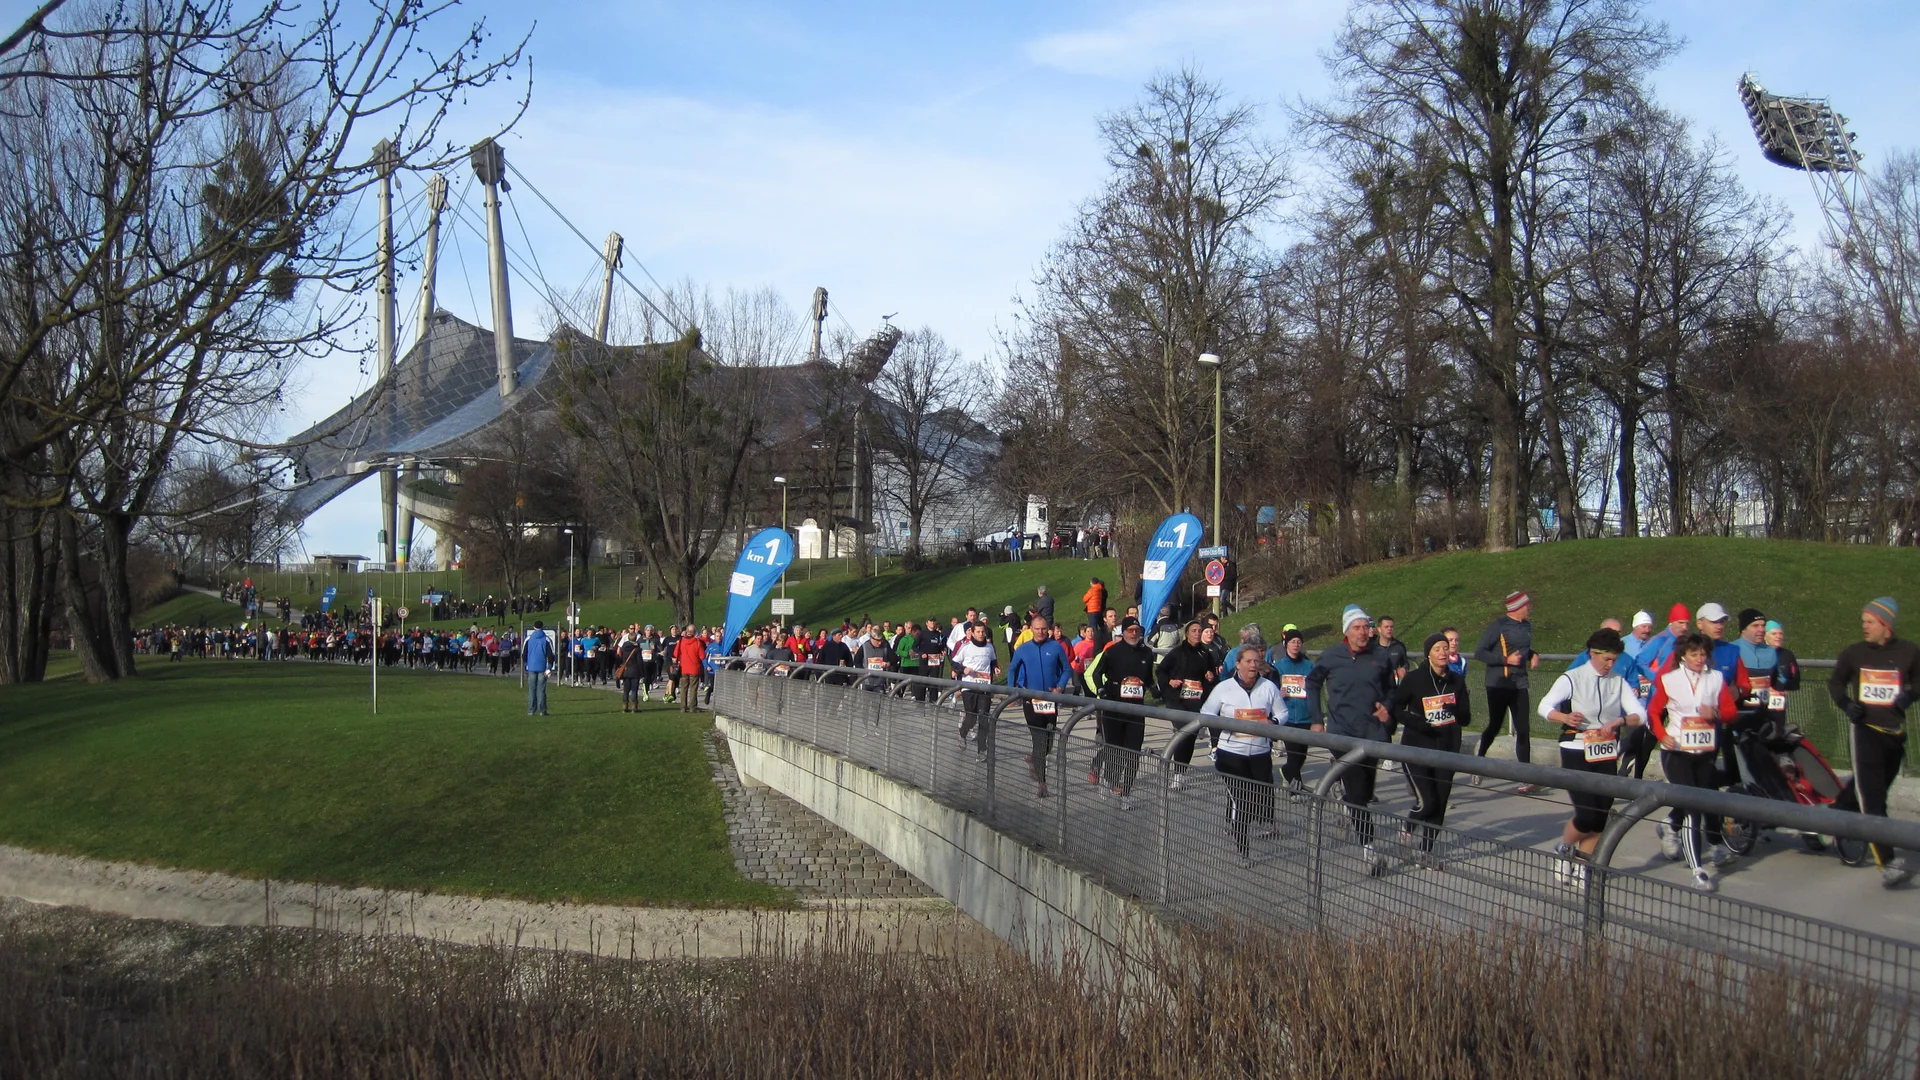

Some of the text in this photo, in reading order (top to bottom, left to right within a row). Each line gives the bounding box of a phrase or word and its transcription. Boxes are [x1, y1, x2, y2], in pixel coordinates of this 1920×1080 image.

[1157, 522, 1188, 548] km 1
[747, 538, 780, 565] km 1
[1864, 686, 1894, 699] 2487
[1684, 732, 1711, 744] 1120
[1587, 743, 1614, 756] 1066
